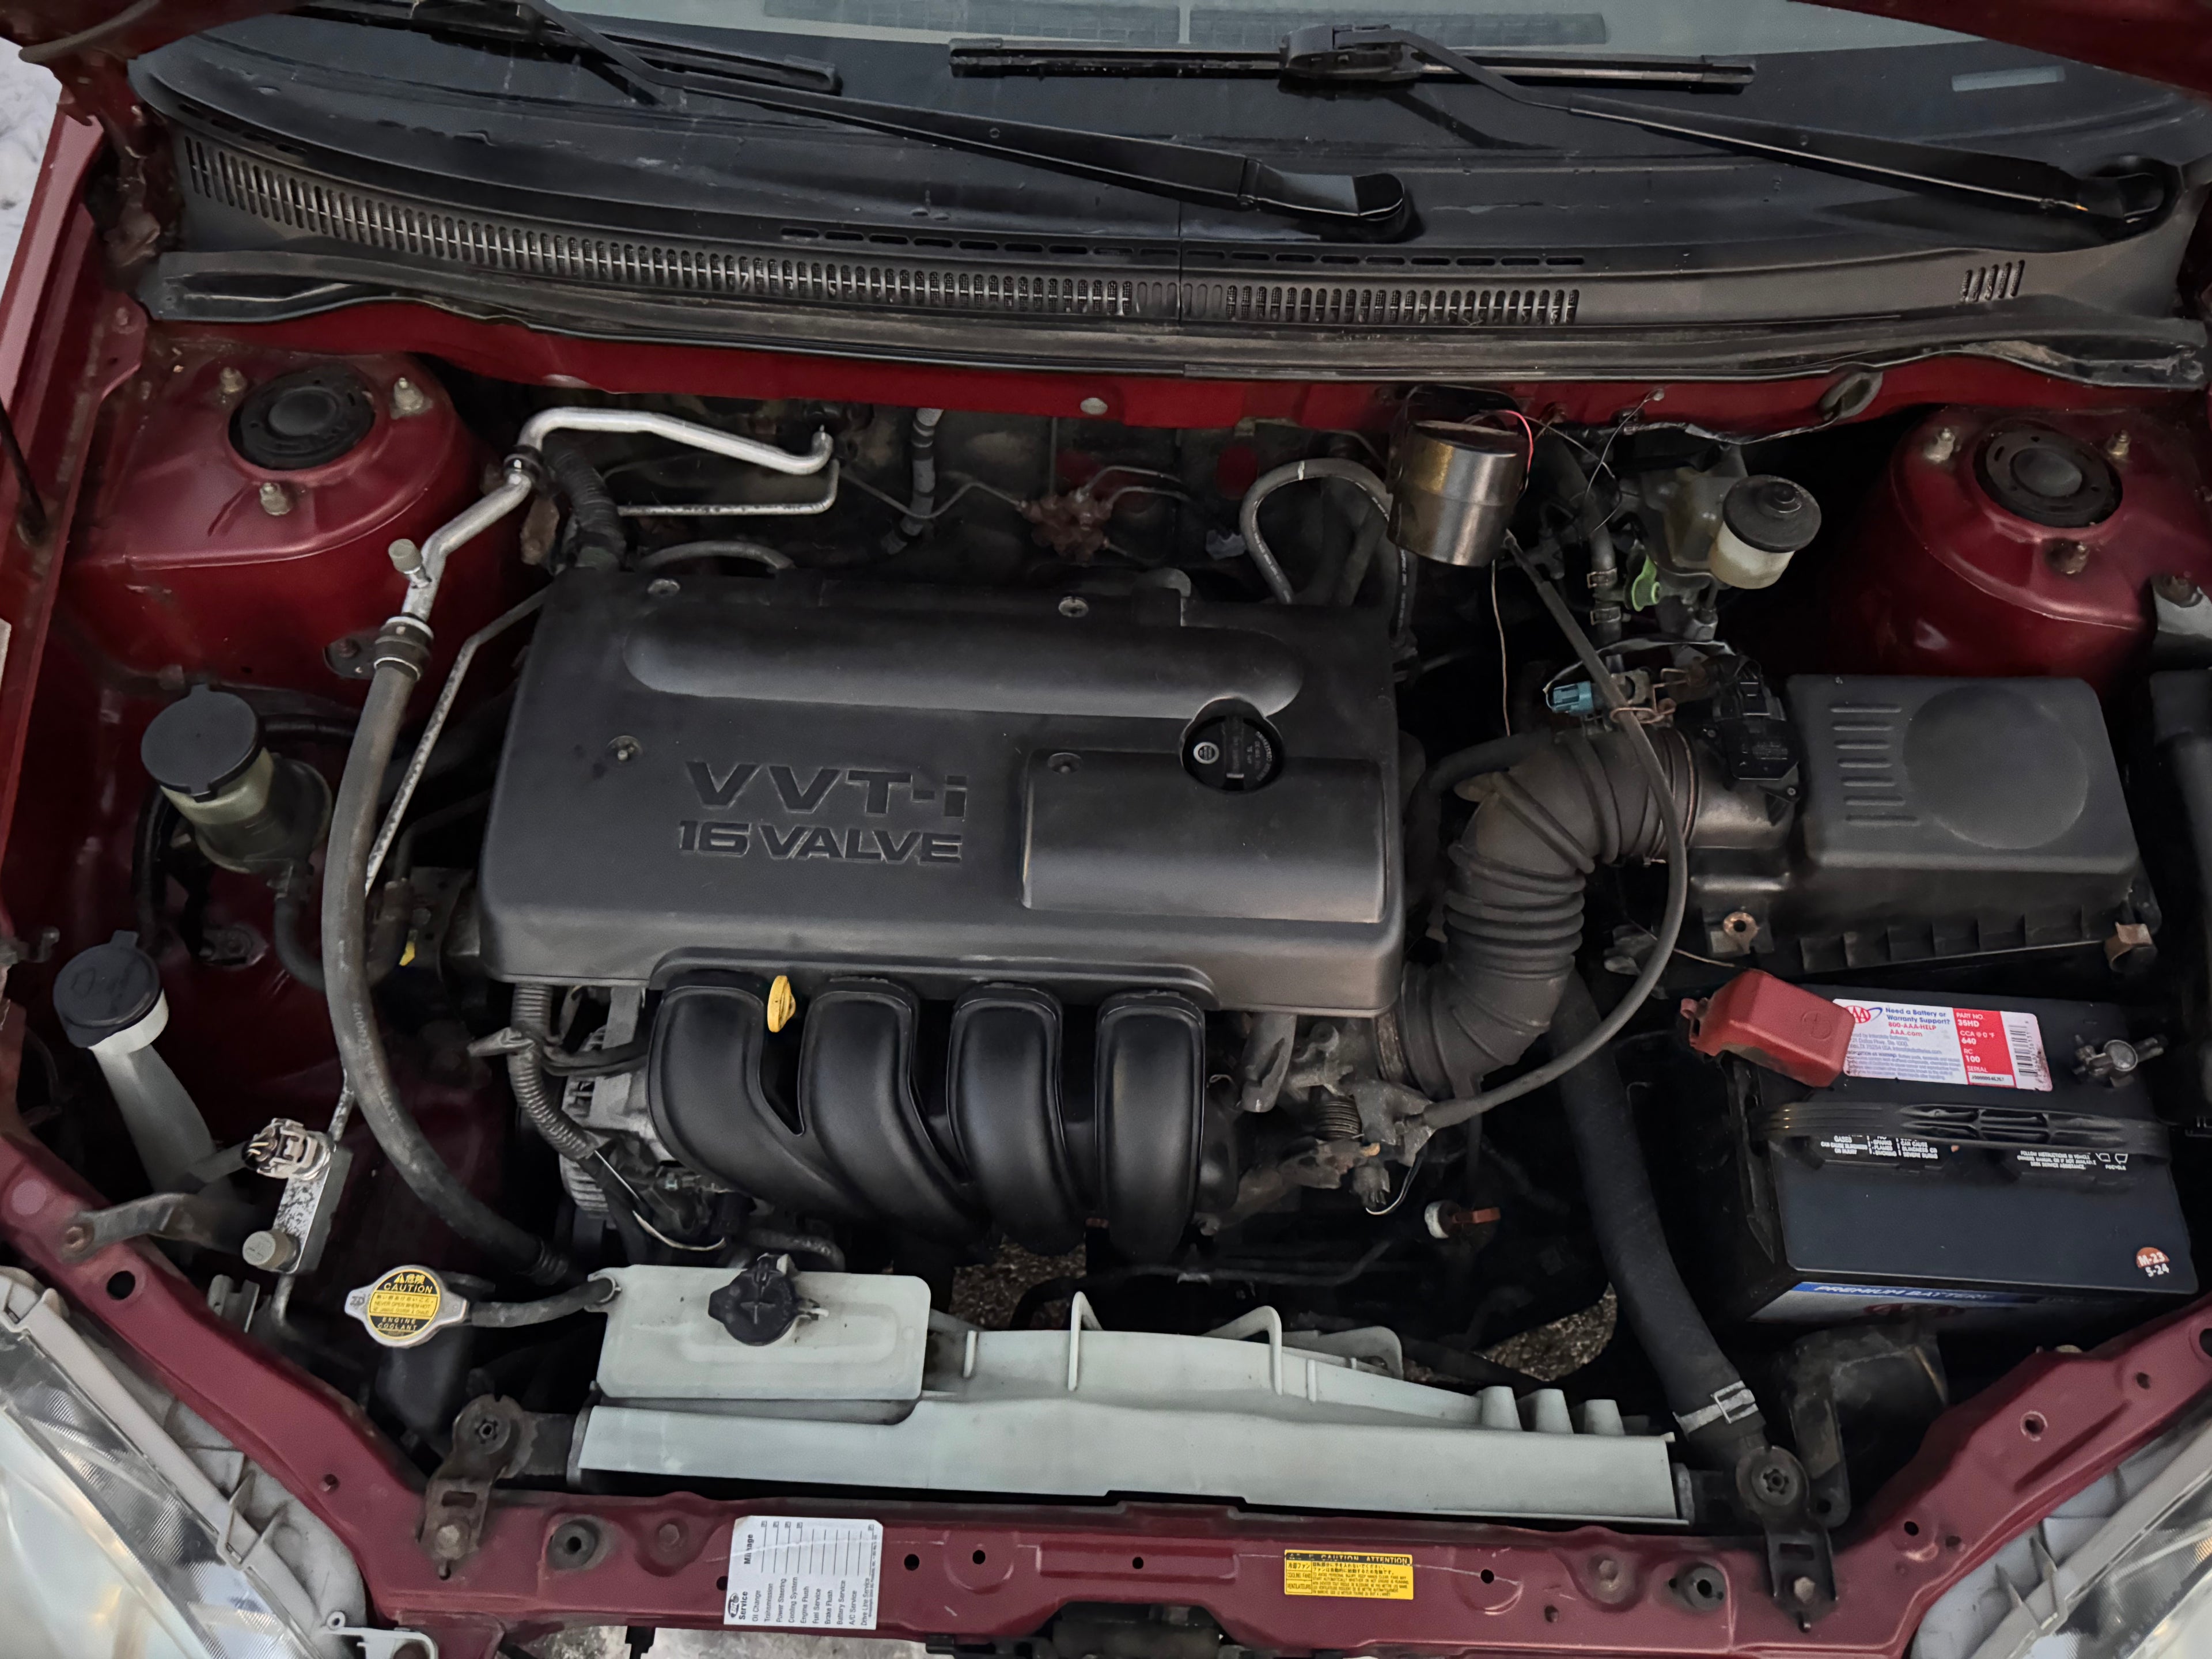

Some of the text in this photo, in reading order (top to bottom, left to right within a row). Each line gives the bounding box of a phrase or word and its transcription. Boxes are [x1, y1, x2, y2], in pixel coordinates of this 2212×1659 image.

[686, 761, 968, 818] VVT-i
[679, 820, 963, 866] 16 VALVE
[1846, 1006, 1871, 1024] AA
[1887, 1014, 1918, 1022] Warranty
[1912, 1009, 1937, 1017] Battery
[1888, 1021, 1937, 1031] 800-AAA-HELP
[1957, 1019, 1980, 1028] 35HD
[1890, 1029, 1923, 1037] AAA.com
[2138, 1251, 2165, 1267] M-23
[384, 1283, 433, 1294] CAUTION
[1815, 1285, 1906, 1296] PREMIUM
[377, 1323, 418, 1331] COOLANT
[1366, 1556, 1408, 1566] ATTENTION
[778, 1578, 787, 1603] Steering
[813, 1588, 821, 1611] Service
[738, 1591, 748, 1620] Service
[753, 1590, 762, 1613] Change
[764, 1583, 773, 1622] Transmission
[788, 1577, 798, 1623] Cooling System
[836, 1580, 846, 1624] Battery Service
[800, 1604, 809, 1624] Engine
